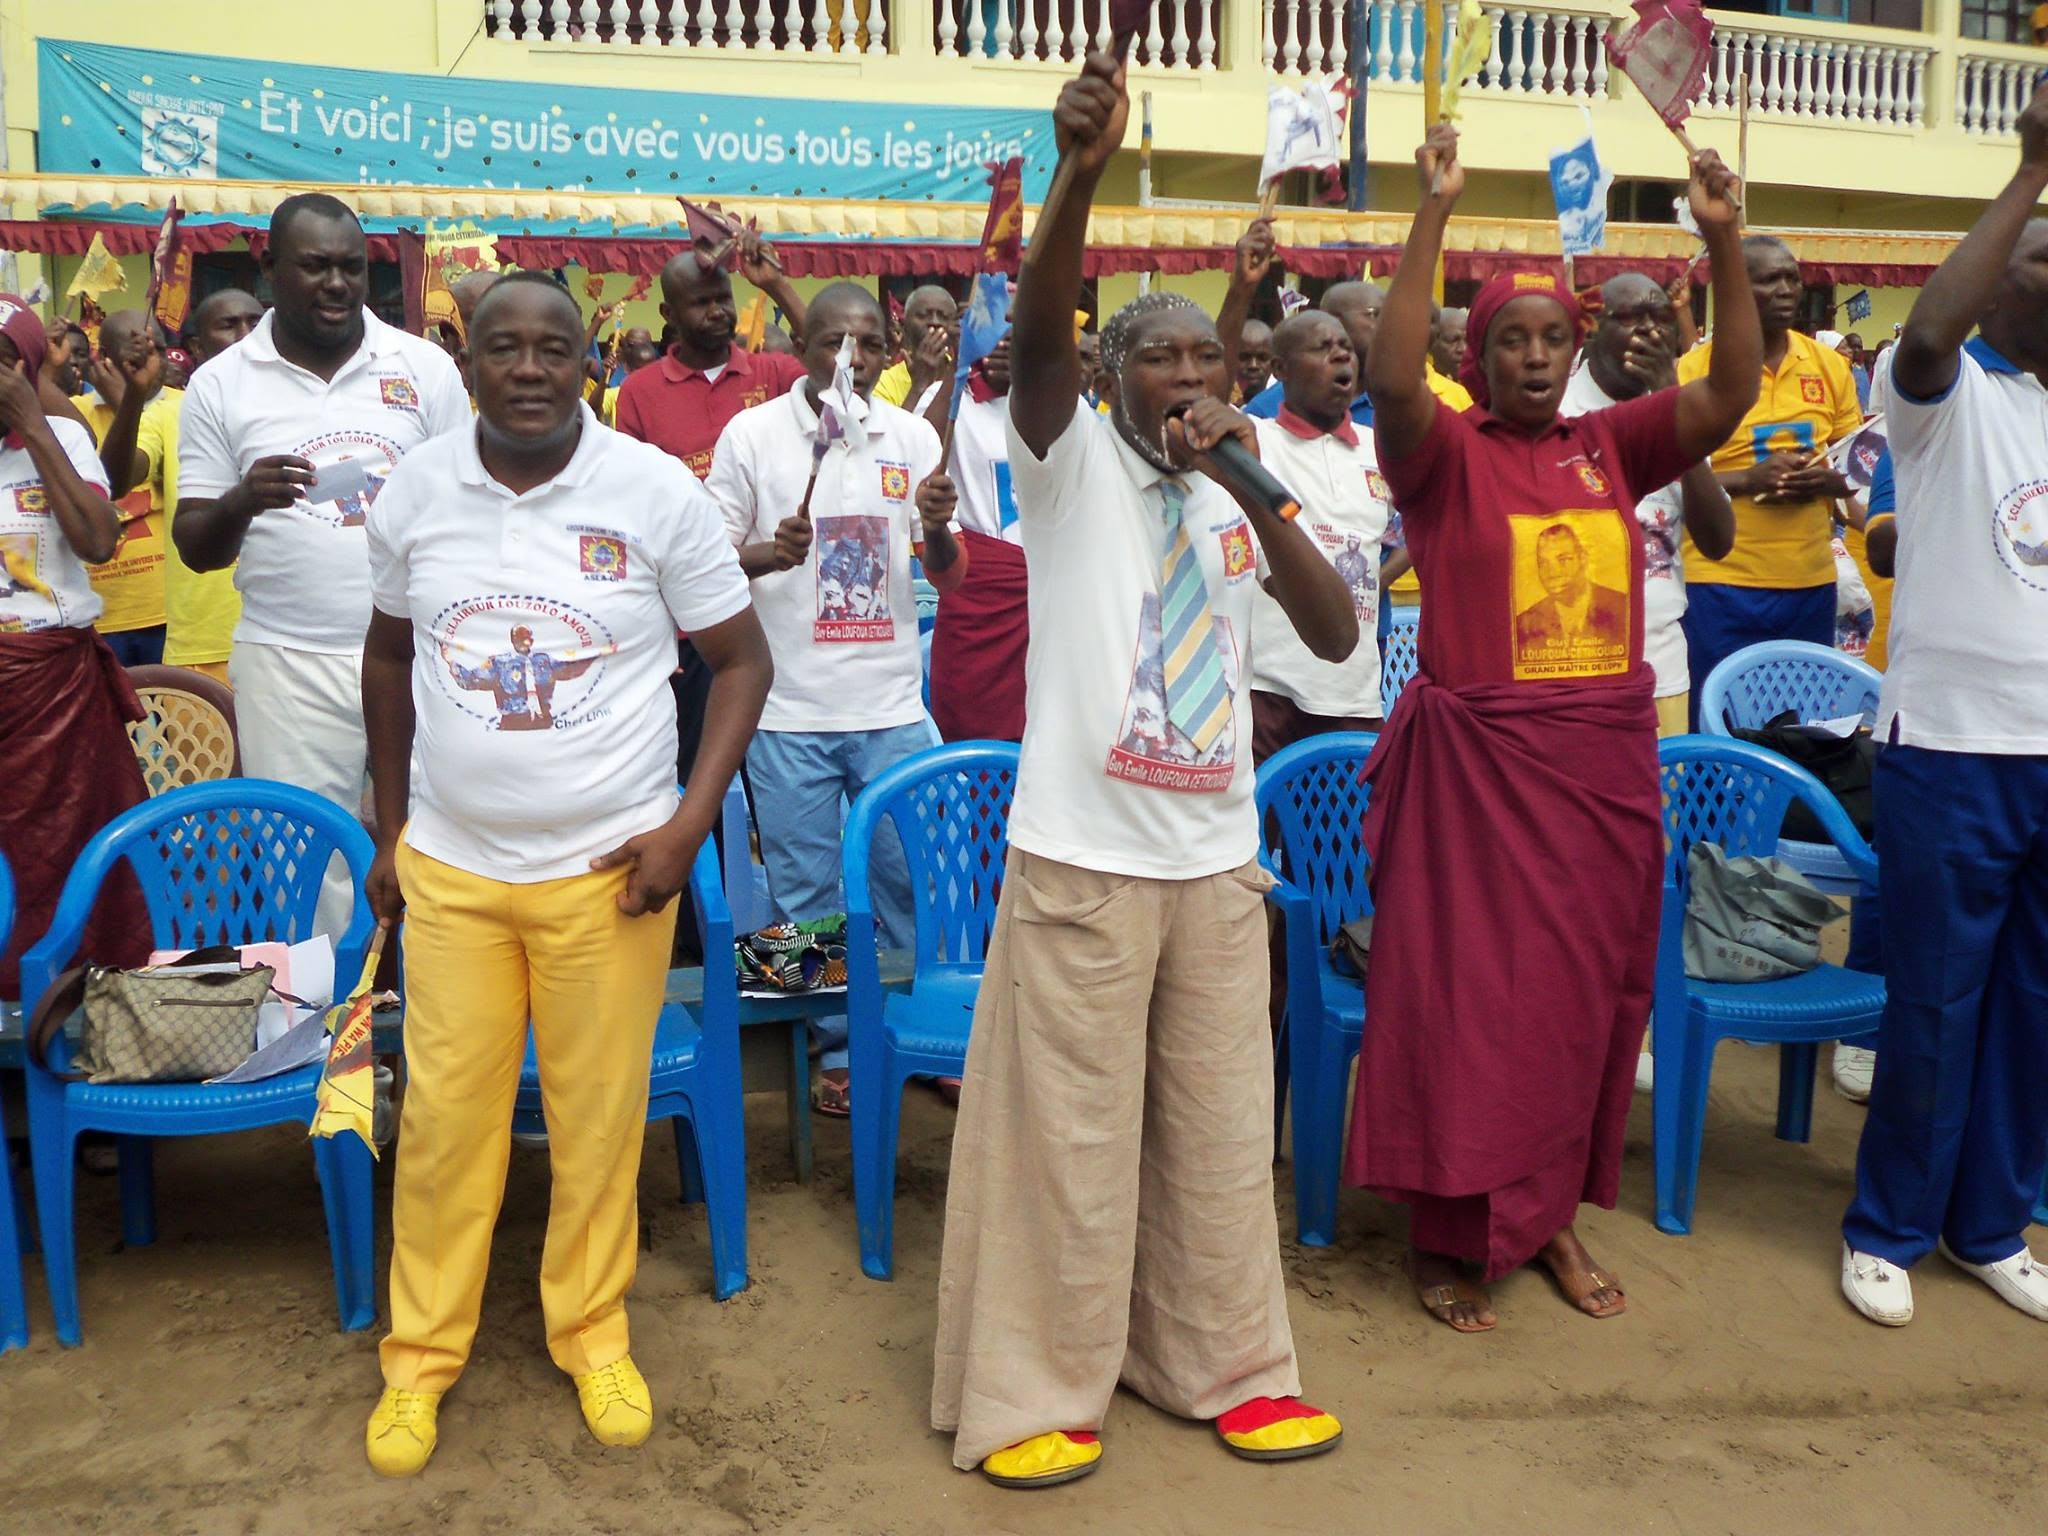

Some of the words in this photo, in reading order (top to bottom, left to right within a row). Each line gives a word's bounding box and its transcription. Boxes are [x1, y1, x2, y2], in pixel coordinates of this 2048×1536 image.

[260, 90, 302, 134] Et
[433, 106, 477, 158] je
[491, 111, 571, 152] suis
[585, 123, 679, 159] avec
[693, 131, 785, 163] vous
[796, 130, 872, 167] tous
[884, 132, 932, 169] les
[498, 600, 558, 617] LOUZOLO
[559, 613, 593, 648] AMOUR
[1524, 664, 1556, 674] GRAND
[1109, 753, 1124, 775] Guy
[1124, 760, 1148, 781] Emile
[1148, 767, 1190, 789] LOUFOUA
